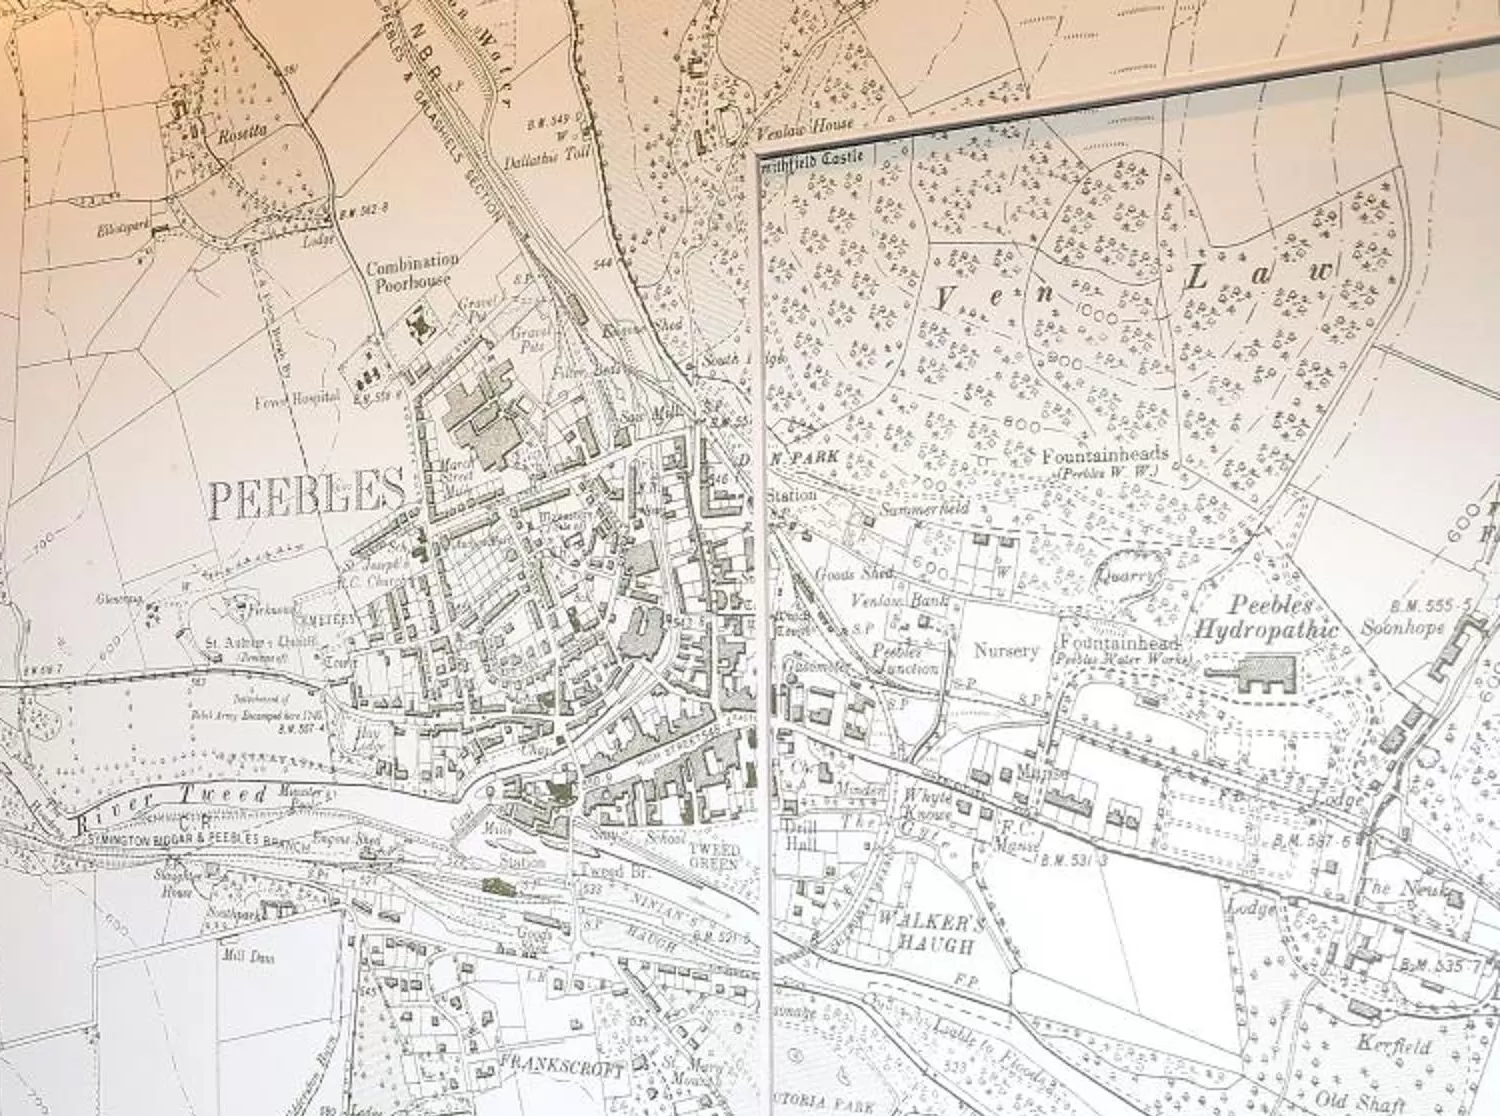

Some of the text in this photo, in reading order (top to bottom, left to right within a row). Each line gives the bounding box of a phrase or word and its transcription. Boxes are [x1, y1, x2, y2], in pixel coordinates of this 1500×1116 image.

[218, 126, 268, 145] Rosetta
[757, 117, 854, 142] Venlaw House
[821, 149, 864, 166] Castle
[366, 253, 459, 277] Combination
[375, 275, 451, 295] Poorhouse
[791, 449, 840, 465] PARK
[1043, 445, 1169, 464] Fountainheads
[207, 466, 406, 521] PEEBLES
[767, 488, 817, 503] Station
[879, 502, 970, 519] Summerfield
[1447, 503, 1481, 543] 600
[815, 565, 896, 582] Goods Shed
[1098, 567, 1159, 588] Quarry
[1226, 594, 1314, 616] Peebles
[1195, 618, 1340, 646] Hydropathic
[974, 641, 1040, 662] Nursery
[1059, 634, 1179, 652] Fountainhead
[180, 783, 268, 804] Tweed
[1311, 787, 1366, 808] Lodge
[781, 818, 817, 834] Drill
[88, 834, 150, 848] SYMINGTON
[152, 833, 193, 848] BIGGAR
[208, 831, 259, 846] PEEBLES
[786, 835, 817, 851] Hall
[688, 843, 741, 858] TWEED
[689, 857, 739, 870] GREEN
[1228, 898, 1277, 921] Lodge
[878, 909, 987, 936] WALKER'S
[899, 933, 975, 956] HAUGH
[1357, 1032, 1432, 1061] Kerfield
[498, 1052, 626, 1080] FRANKSCROFT
[834, 1097, 876, 1115] PARK
[1314, 1089, 1406, 1115] Old Shaft
